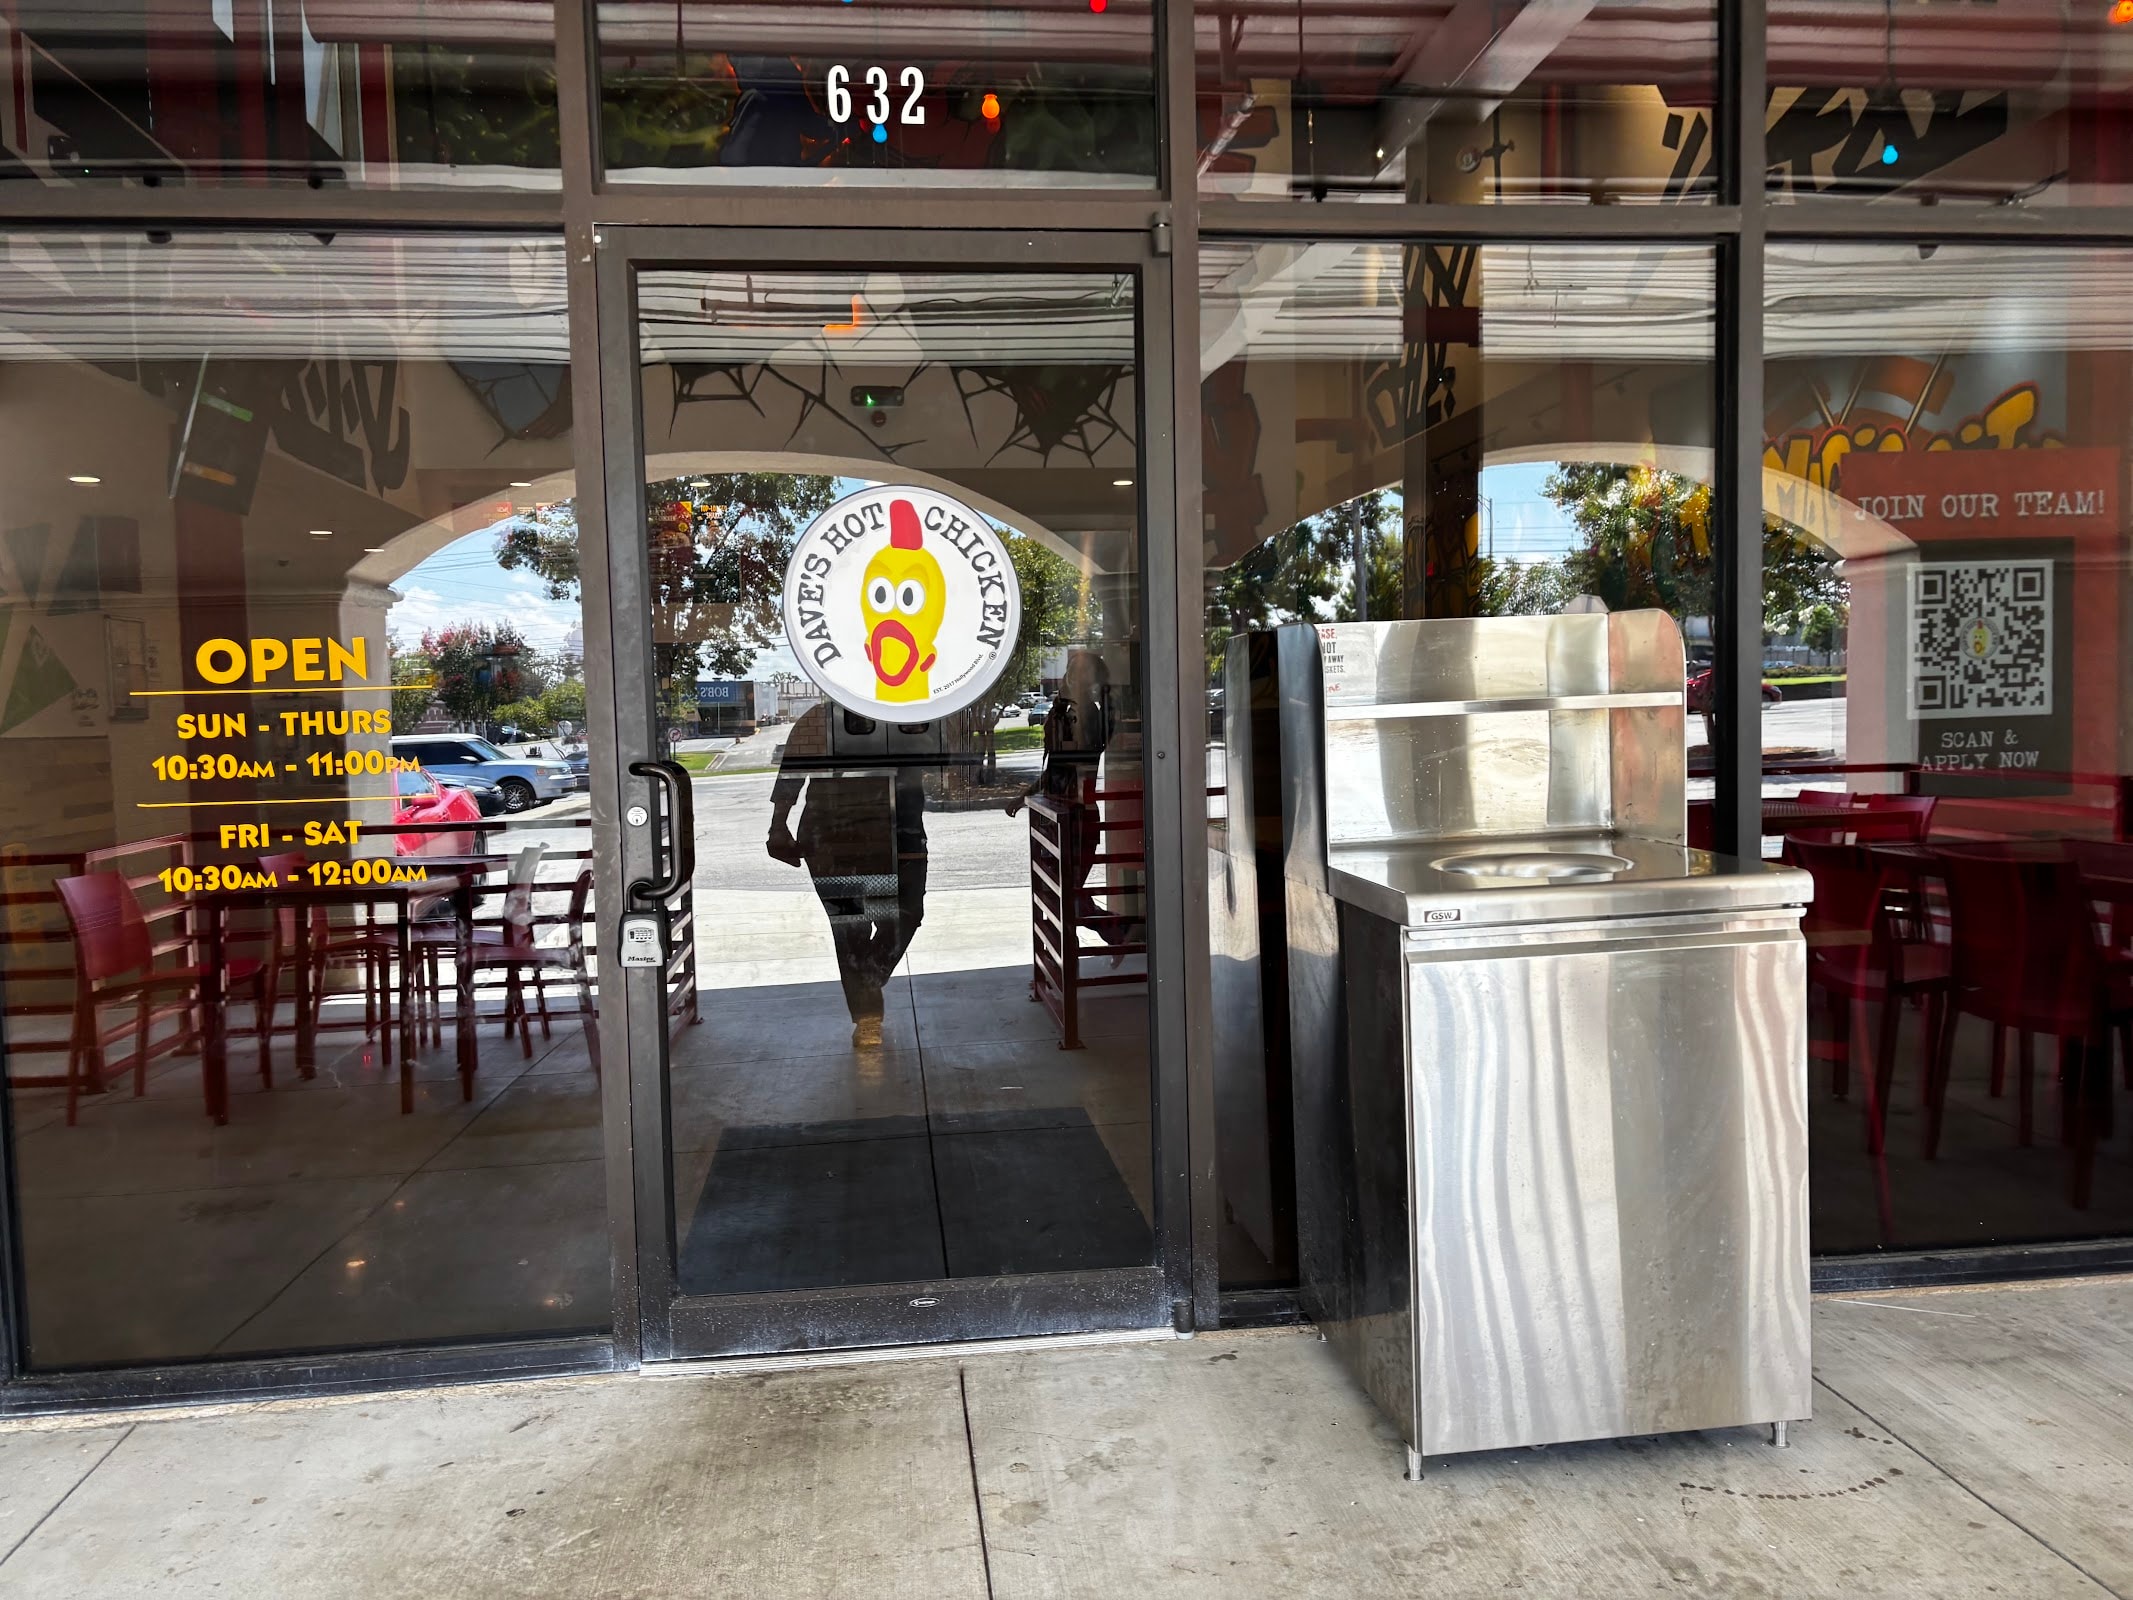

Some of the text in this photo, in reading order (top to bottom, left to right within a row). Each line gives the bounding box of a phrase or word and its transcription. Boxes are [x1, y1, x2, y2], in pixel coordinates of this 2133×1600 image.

[827, 64, 926, 125] 632
[1854, 489, 2105, 521] JOIN OUR TEAM!
[797, 502, 1008, 670] DAVE'S HOT CHICKEN
[196, 636, 368, 685] OPEN
[1324, 664, 1346, 673] SKETS.
[176, 709, 392, 739] SUN - THURS
[1940, 729, 2019, 749] SCAN &
[285, 764, 298, 772] -
[1920, 751, 2040, 772] APPLY NOW
[219, 820, 363, 850] FRI - SAT
[287, 873, 300, 882] -
[1431, 912, 1453, 920] GSW
